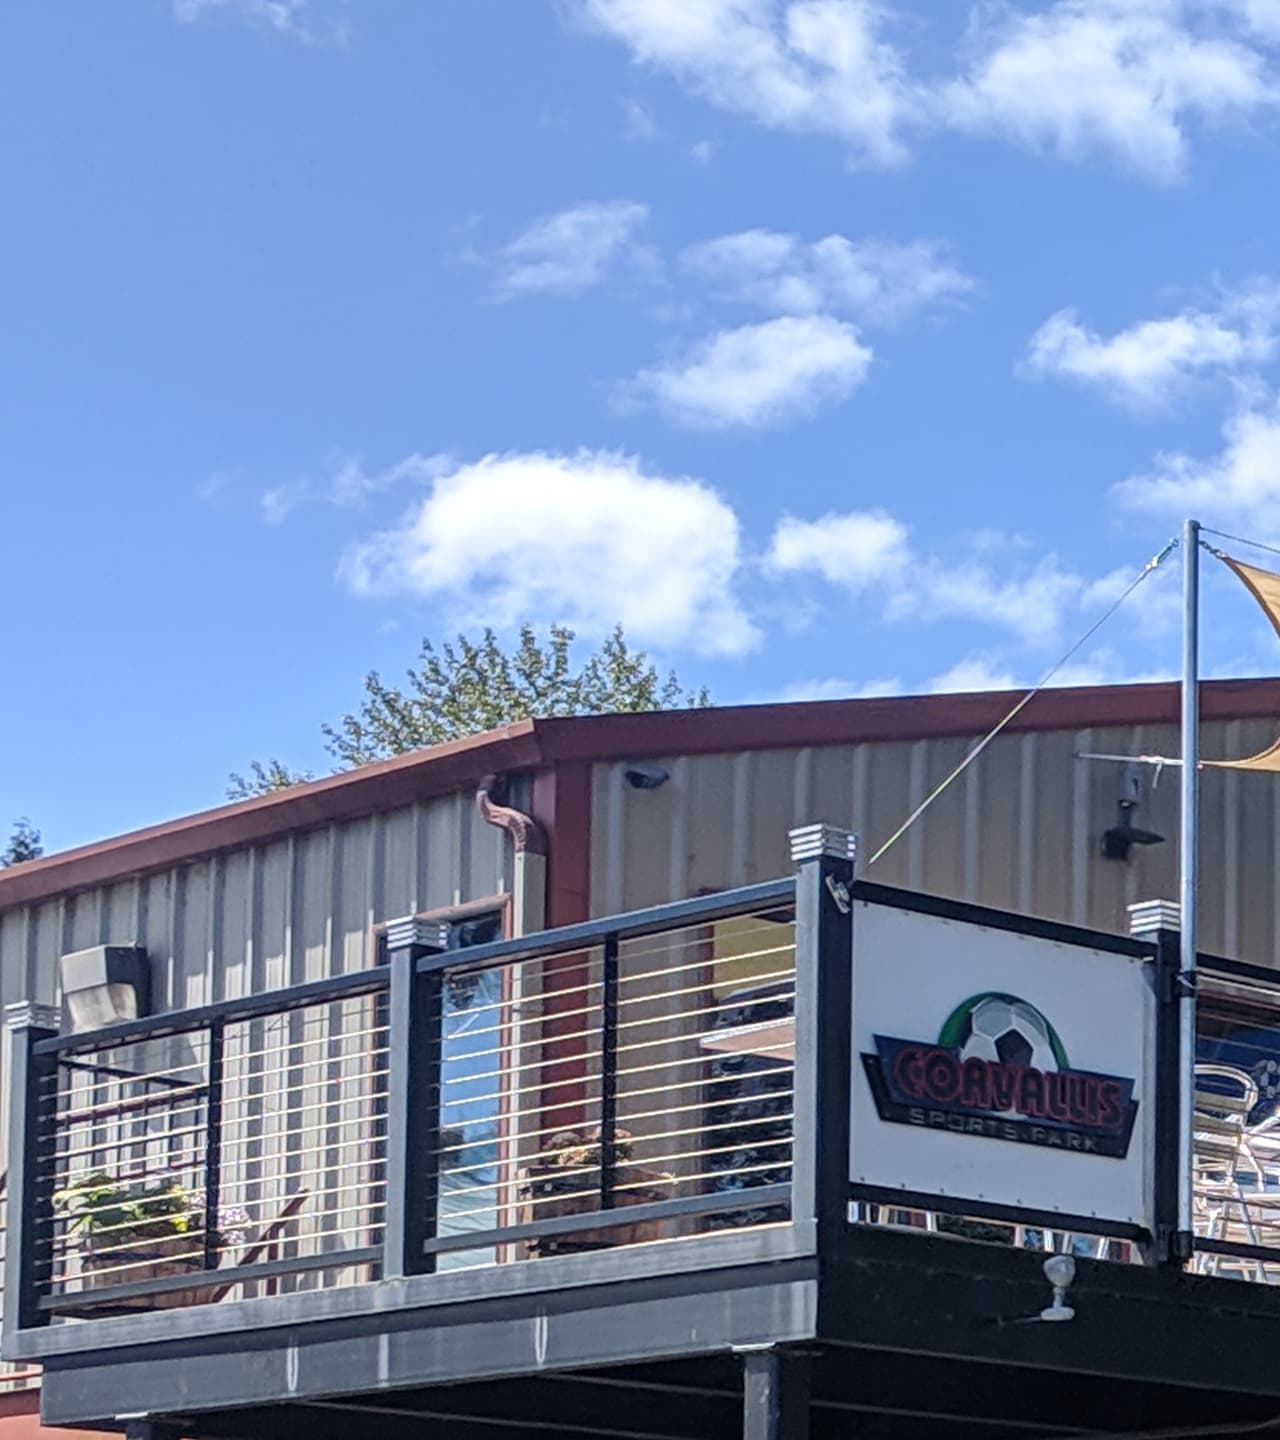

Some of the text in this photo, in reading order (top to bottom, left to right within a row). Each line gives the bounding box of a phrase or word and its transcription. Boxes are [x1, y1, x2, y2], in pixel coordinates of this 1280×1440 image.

[894, 1045, 1124, 1129] CORVALLIS
[909, 1107, 1098, 1152] SPORTS PARK
